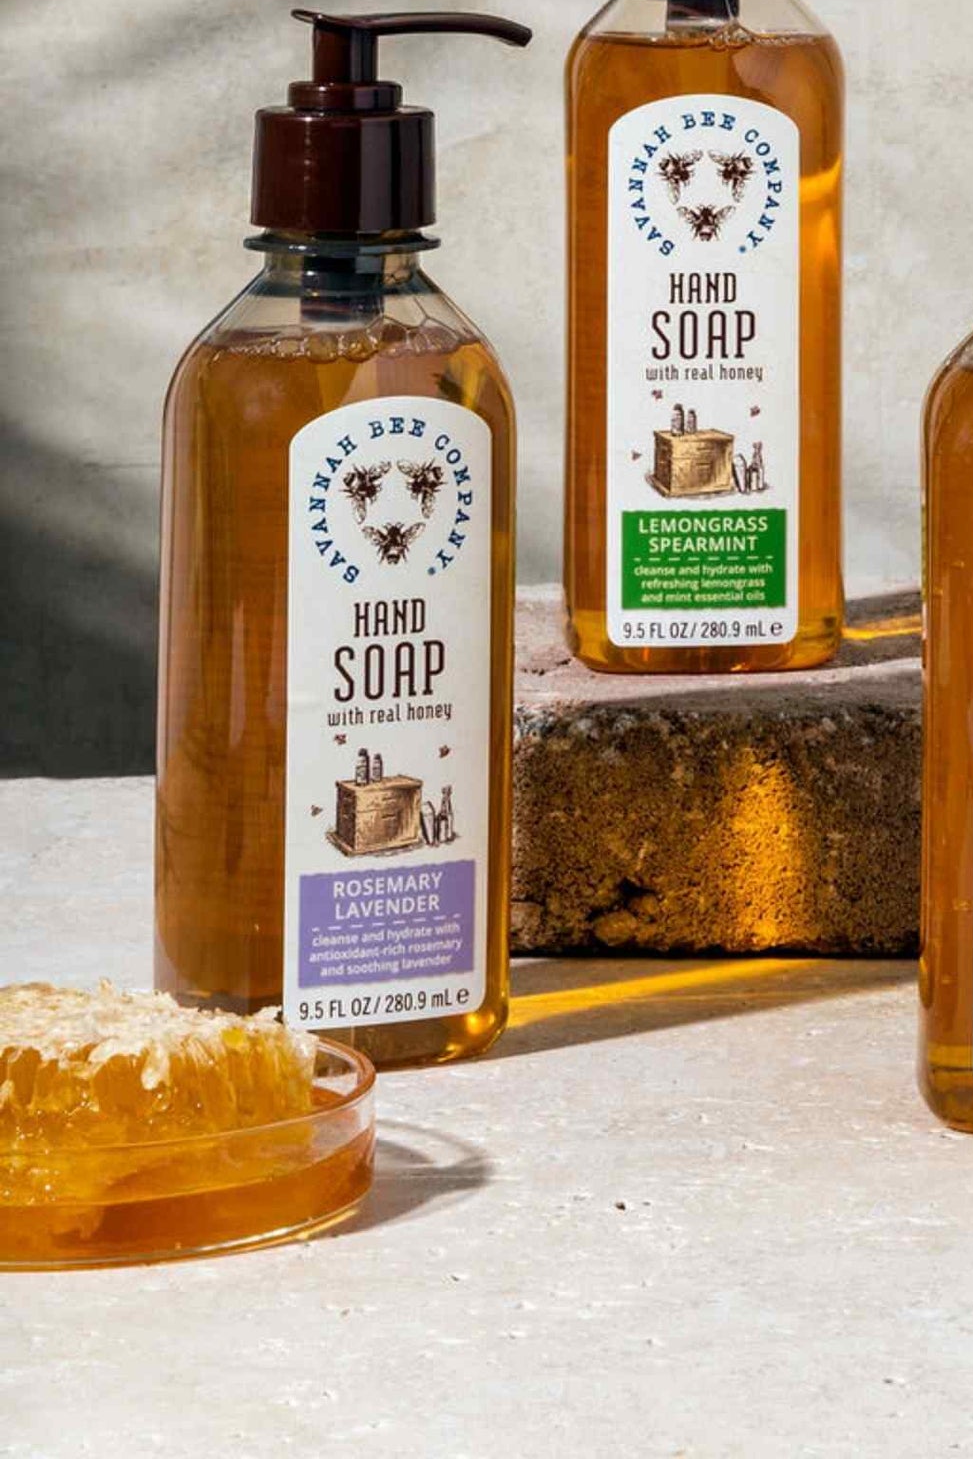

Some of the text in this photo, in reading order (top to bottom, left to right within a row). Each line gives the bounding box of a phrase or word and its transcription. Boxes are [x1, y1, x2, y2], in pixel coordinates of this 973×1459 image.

[629, 126, 674, 256] SAVANNAH
[683, 111, 736, 131] BEE
[669, 273, 737, 304] HAND
[652, 311, 755, 359] SOAP
[646, 364, 763, 382] with real honey
[309, 434, 360, 583] SAVANNAH
[369, 417, 426, 439] BEE
[638, 516, 768, 533] LEMONGRASS
[649, 536, 758, 553] SPEARMINT
[634, 563, 772, 577] cleanse and hydrate with
[641, 577, 765, 591] refreshing lemongrass
[642, 590, 765, 603] and mint essential oils
[354, 598, 426, 638] HAND
[623, 623, 645, 639] 9.5
[650, 623, 664, 639] FL
[745, 621, 766, 637] mL
[334, 640, 445, 702] SOAP
[328, 703, 452, 726] with real honey
[333, 871, 443, 898] ROSEMARY
[335, 894, 441, 920] LAVENDER
[312, 924, 460, 947] cleanse and hydrate with
[309, 939, 463, 963] antioxidant-rich rosemary
[320, 953, 452, 977] and soothing lavender
[299, 1001, 324, 1021] 9.5
[330, 1000, 346, 1018] FL
[431, 990, 452, 1008] mL
